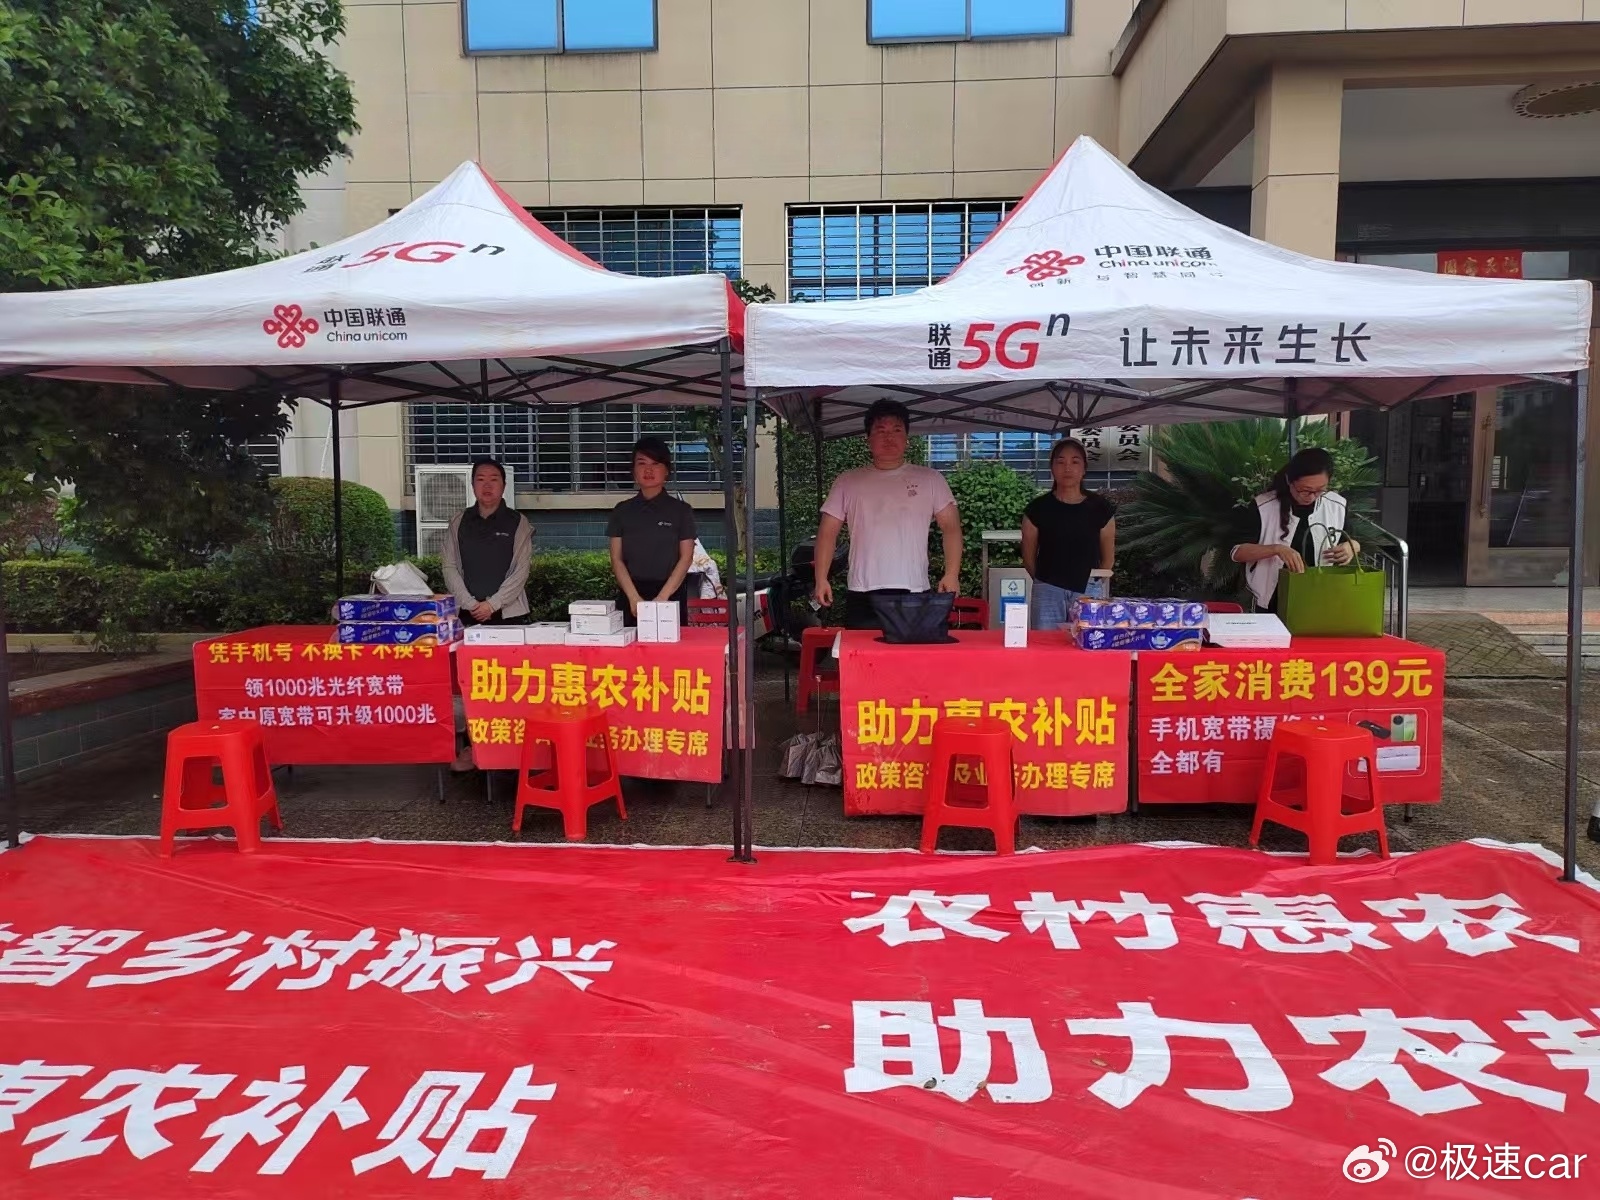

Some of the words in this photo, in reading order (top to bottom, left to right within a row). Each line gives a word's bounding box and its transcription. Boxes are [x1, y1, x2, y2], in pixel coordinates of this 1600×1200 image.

[1094, 245, 1213, 260] 中国联通
[1098, 258, 1150, 269] China
[323, 307, 407, 328] 中国联通
[326, 331, 361, 342] China
[363, 331, 408, 342] unicom
[928, 323, 951, 370] 联通
[1119, 322, 1372, 367] 让未来生长
[245, 674, 404, 698] 领1000兆光纤宽带
[470, 657, 712, 716] 助力惠农补贴
[1150, 658, 1433, 702] 全家消费139元
[467, 716, 710, 757] 政策咨务办理专席
[1149, 714, 1325, 742] 手机宽带摄
[855, 761, 1116, 790] 政策咨及业办理专席
[1150, 748, 1225, 775] 全都有
[842, 889, 1581, 957] 农村惠农
